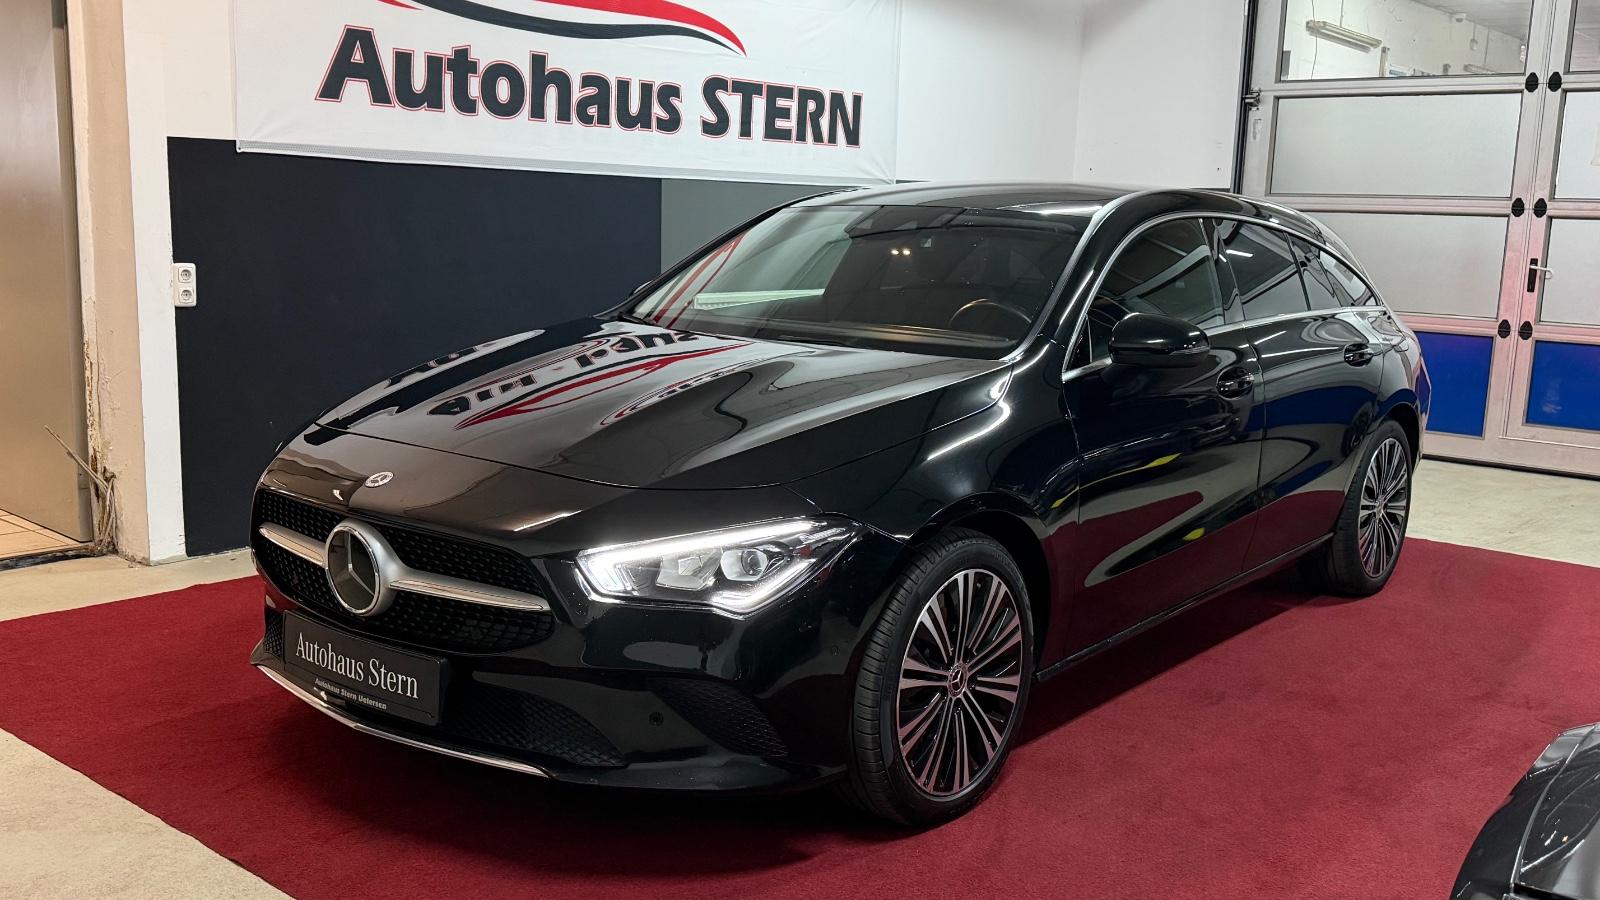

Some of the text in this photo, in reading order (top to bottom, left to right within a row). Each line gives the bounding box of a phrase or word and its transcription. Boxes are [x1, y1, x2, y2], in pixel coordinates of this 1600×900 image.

[315, 24, 863, 149] Autohaus STERN
[296, 632, 419, 699] Autohaus Stern
[314, 678, 340, 694] Autohaus
[340, 689, 357, 700] Stern
